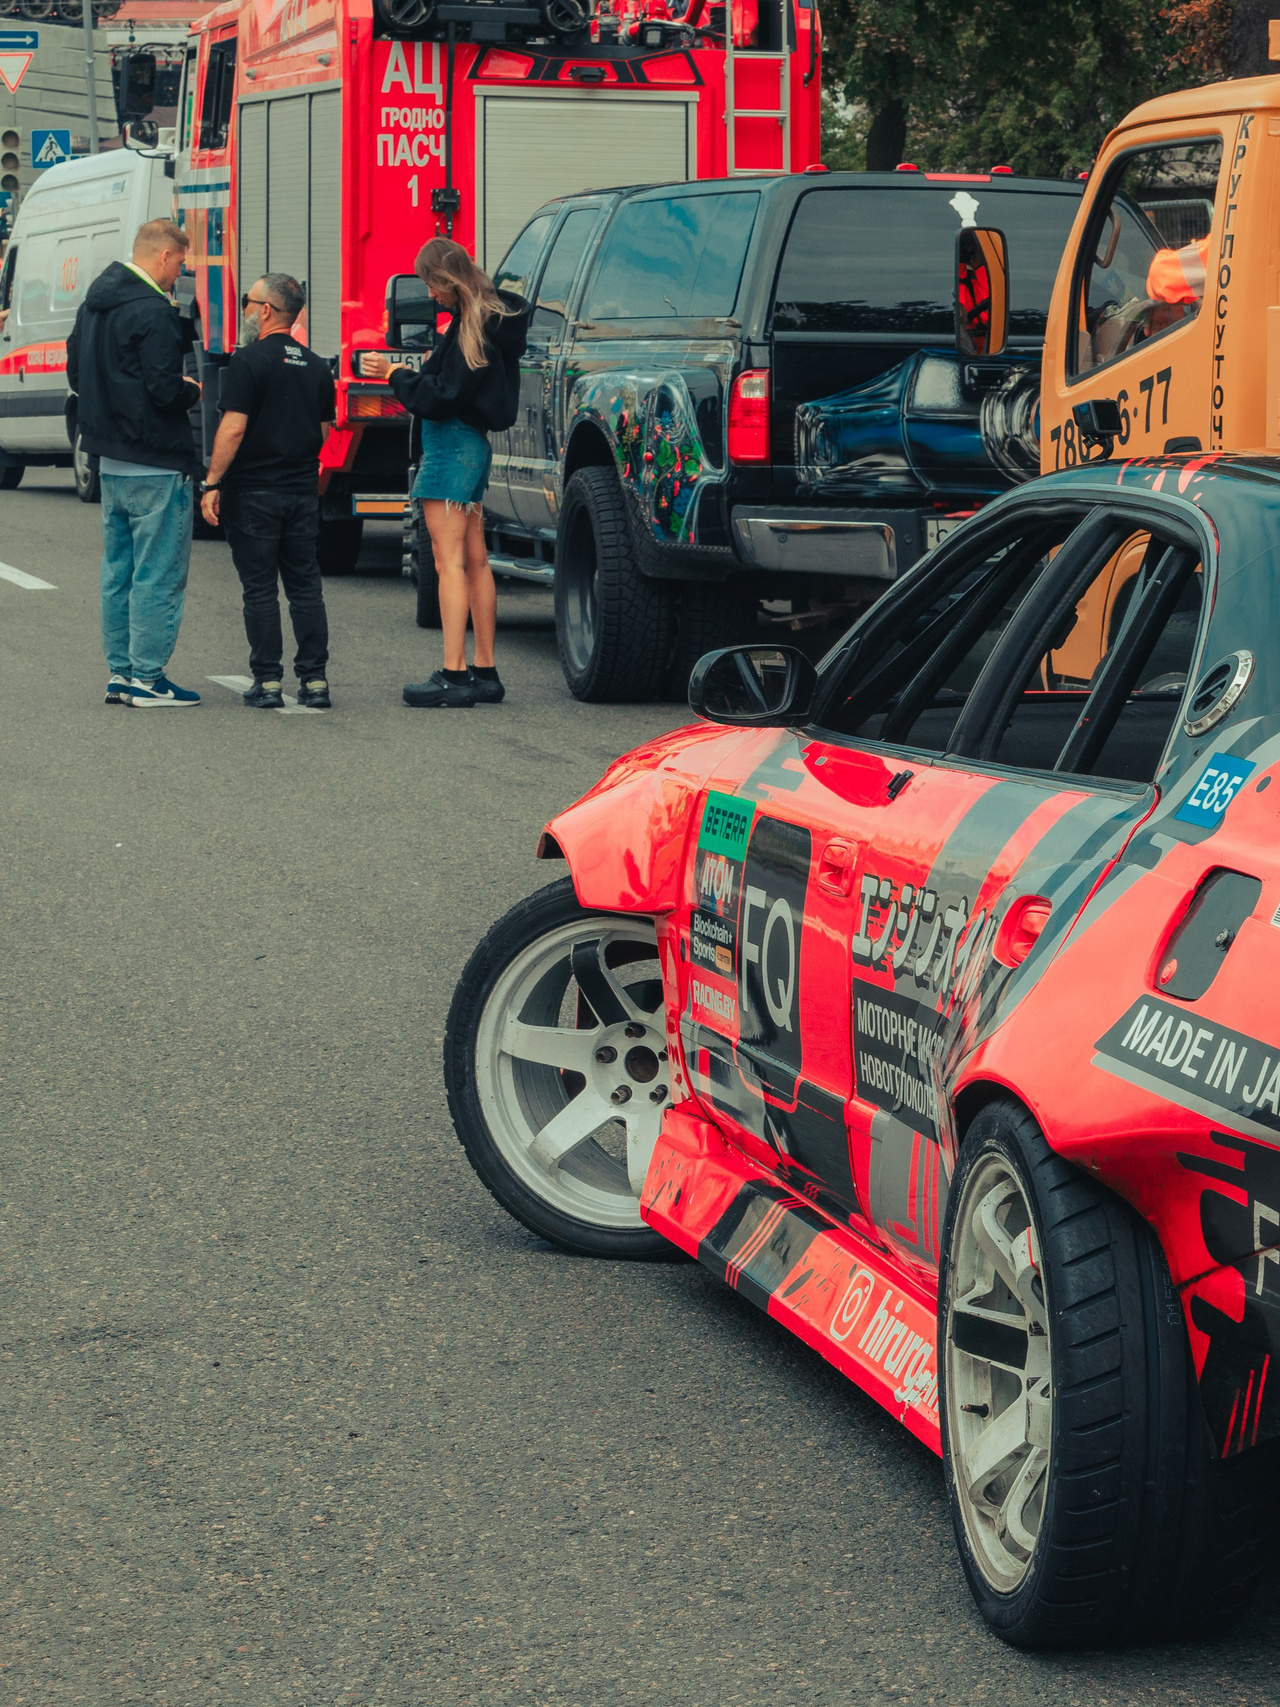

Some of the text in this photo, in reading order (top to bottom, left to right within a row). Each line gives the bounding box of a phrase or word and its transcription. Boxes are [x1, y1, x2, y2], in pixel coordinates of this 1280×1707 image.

[380, 41, 443, 105] АЦ
[381, 107, 445, 132] ГРОДНО
[377, 134, 446, 167] ПАСЧ
[407, 174, 418, 207] 1
[62, 256, 78, 291] 103
[1212, 115, 1255, 450] КРУГЛОСУТОЧ
[1195, 767, 1242, 814] E85
[700, 857, 734, 904] ATOM
[693, 936, 716, 962] Sports
[741, 884, 796, 1033] FQ
[1120, 1004, 1214, 1078] MADE
[1204, 1038, 1248, 1094] IN
